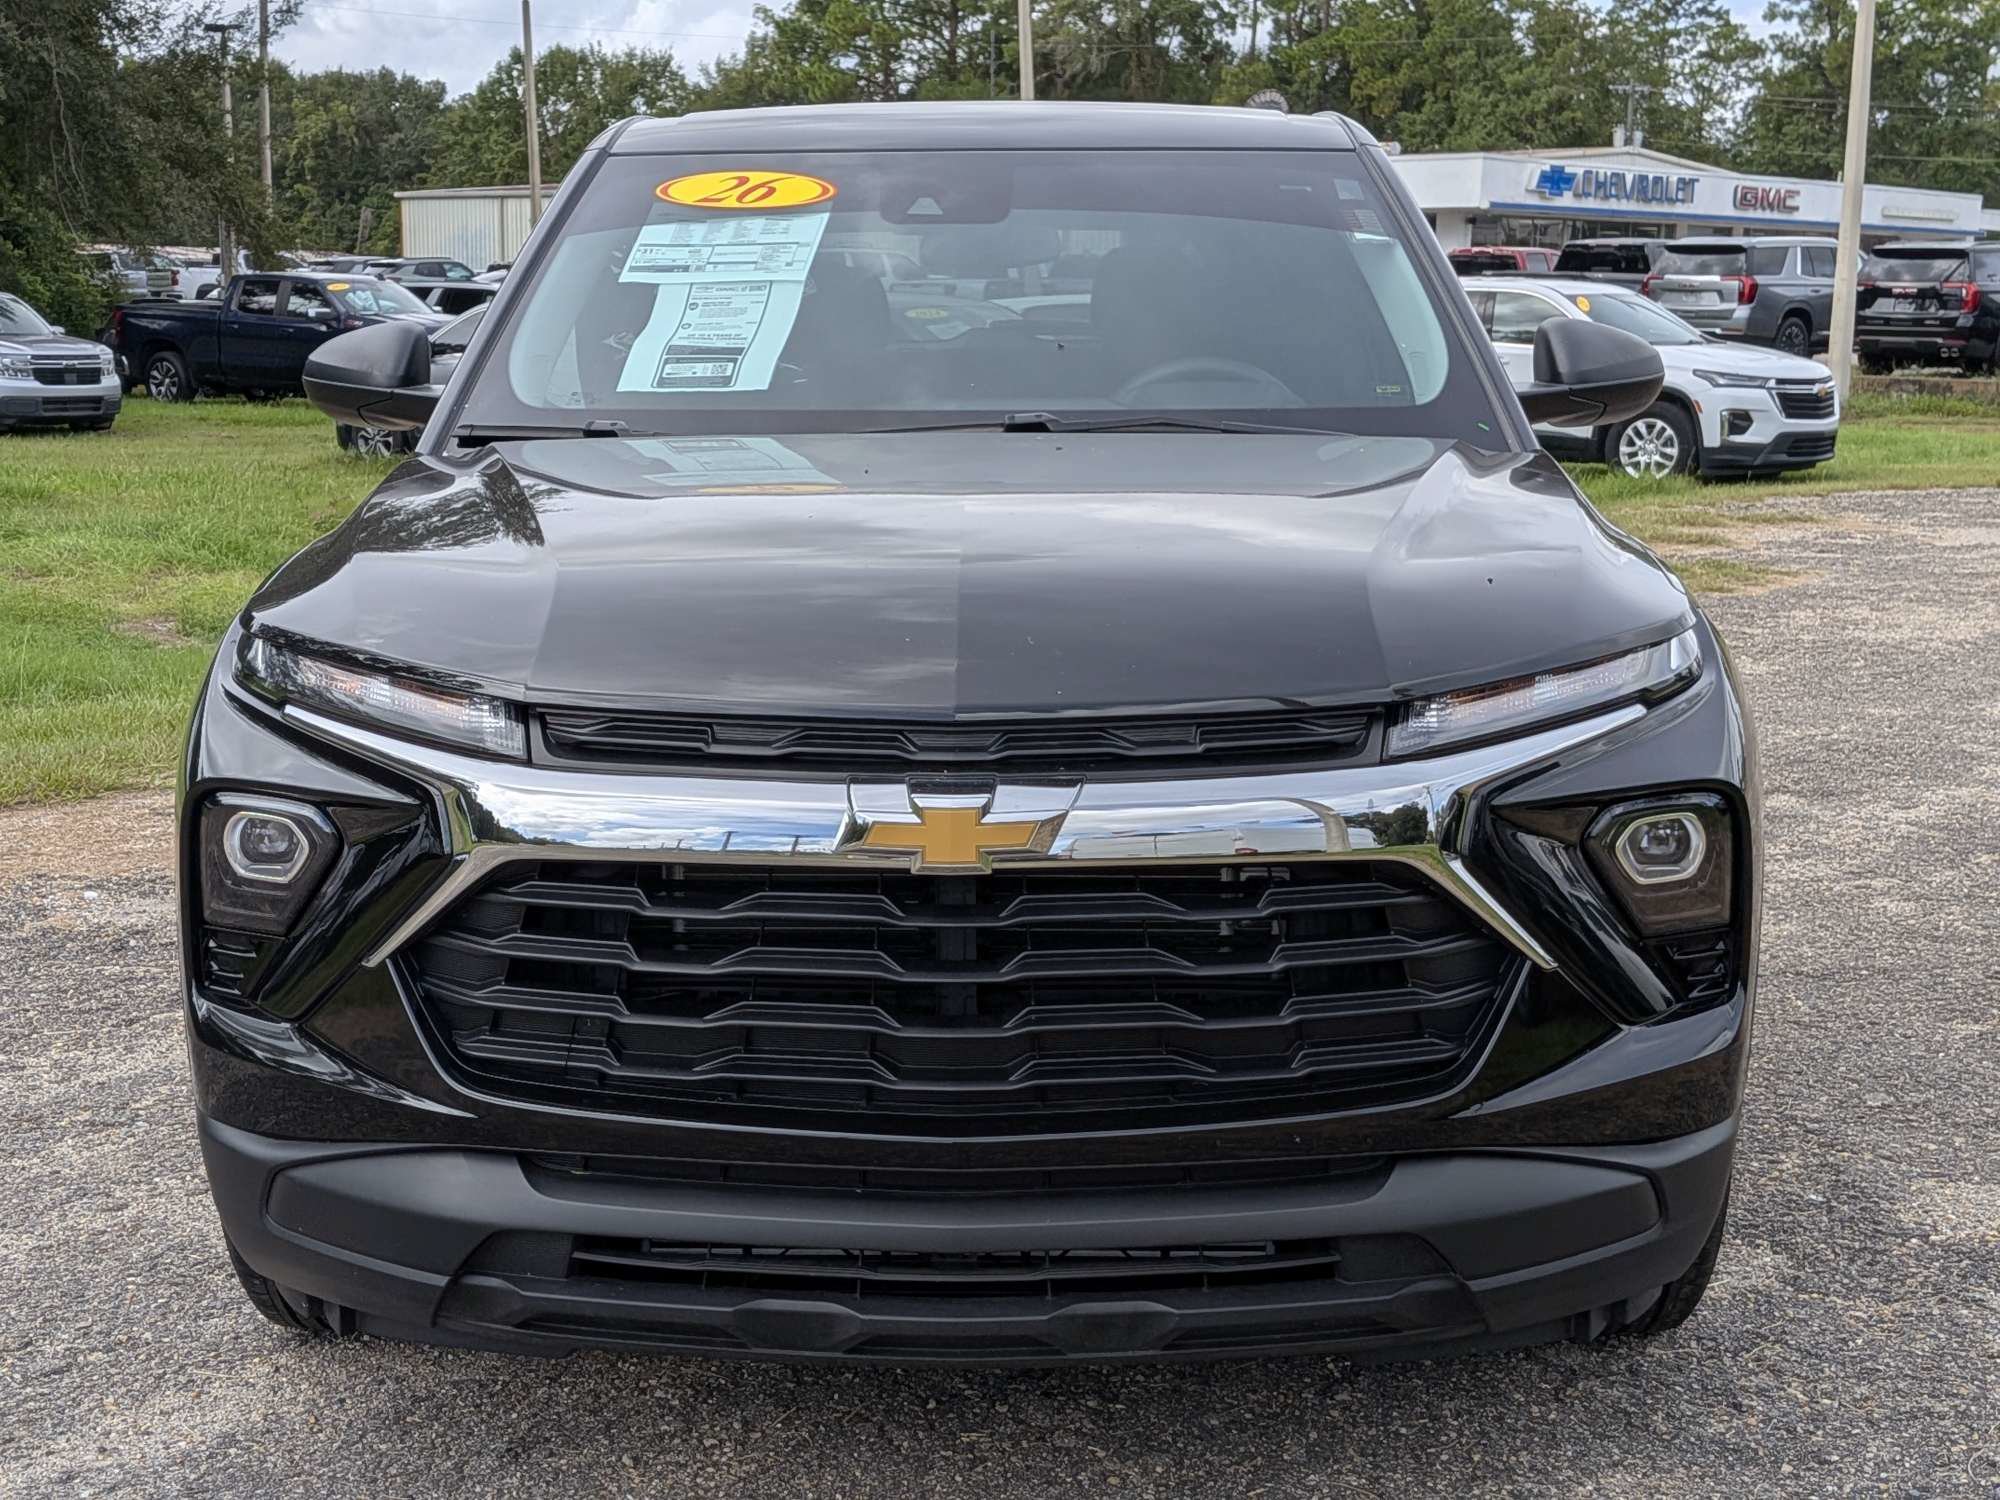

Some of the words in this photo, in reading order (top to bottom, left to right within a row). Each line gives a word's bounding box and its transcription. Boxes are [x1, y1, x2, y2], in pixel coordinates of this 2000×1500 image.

[692, 175, 797, 205] 26
[1579, 170, 1700, 204] CHEVROLET
[1735, 184, 1800, 212] GMC
